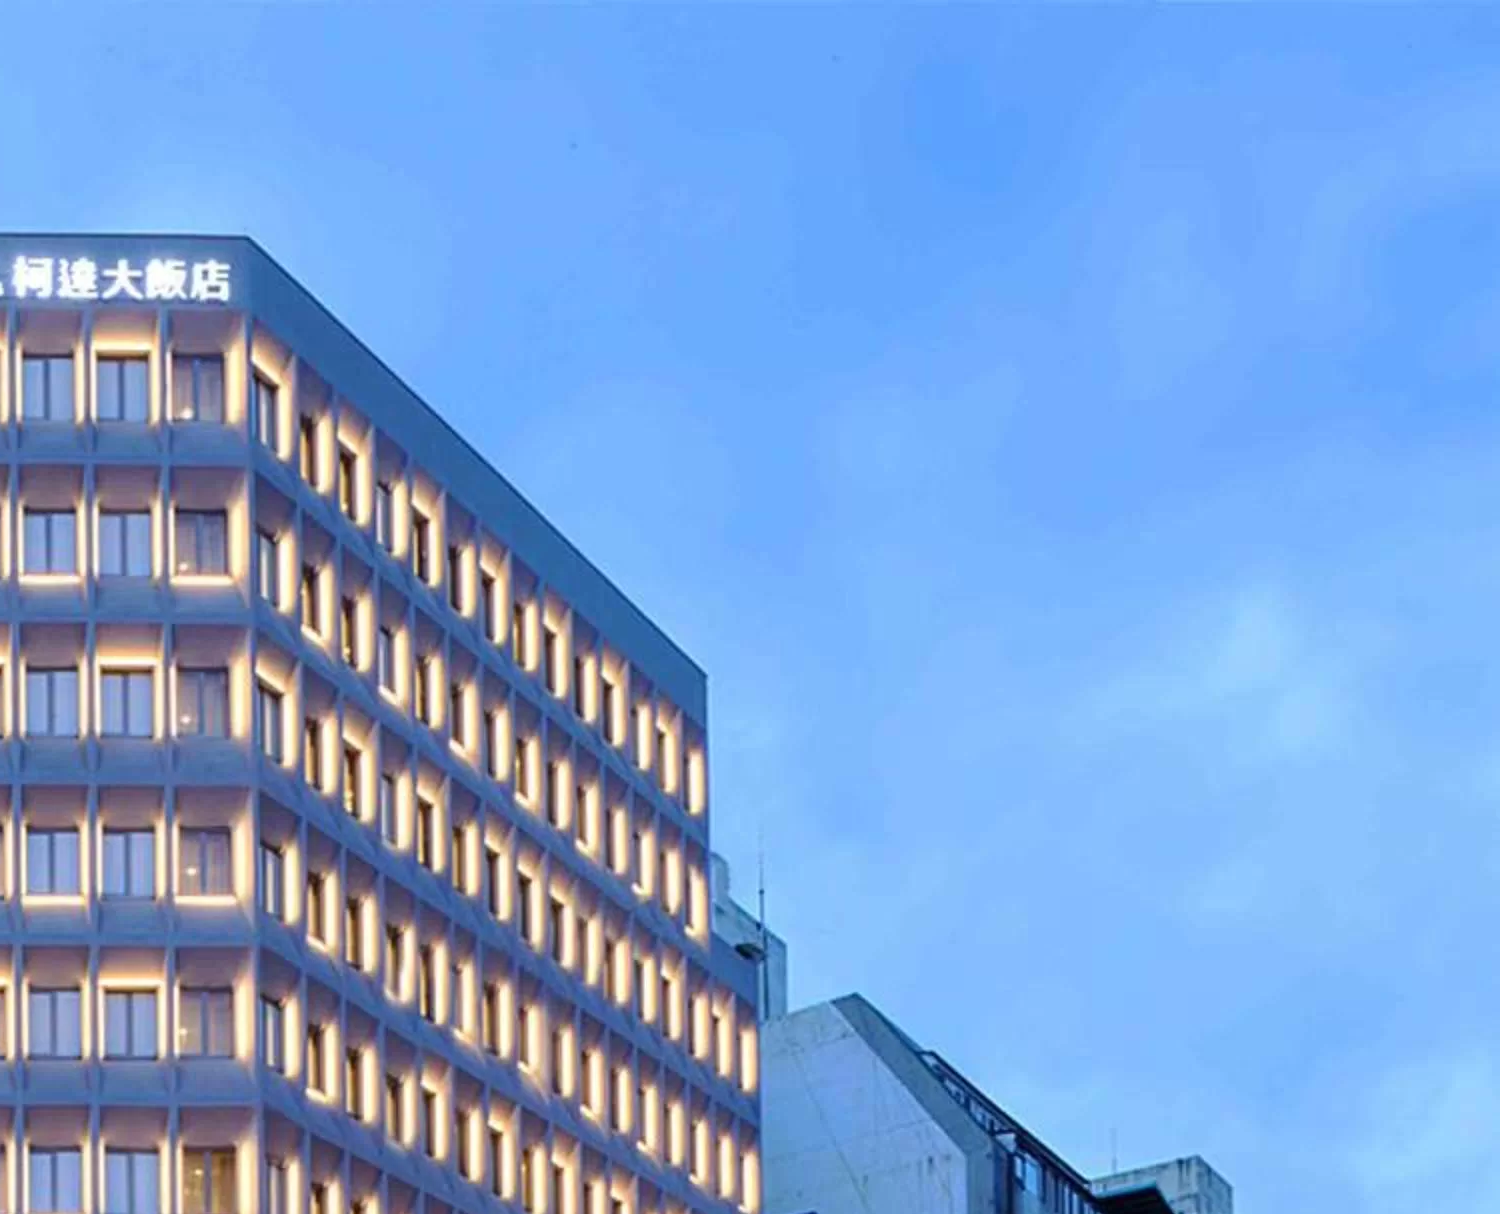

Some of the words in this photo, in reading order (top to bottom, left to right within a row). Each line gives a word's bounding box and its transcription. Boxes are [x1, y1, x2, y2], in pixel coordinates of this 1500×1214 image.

[11, 255, 231, 302] 柯達大飯店
